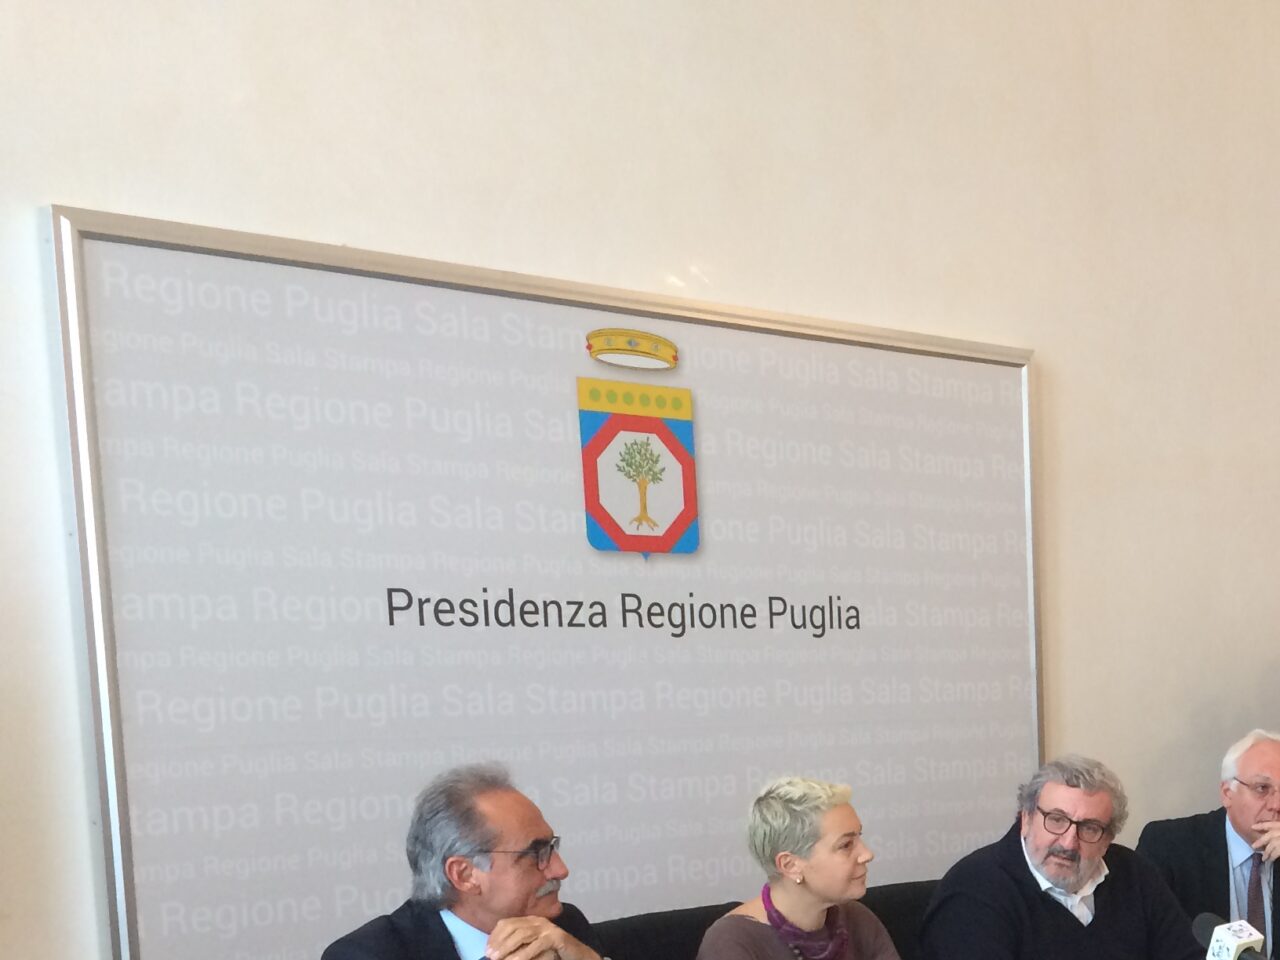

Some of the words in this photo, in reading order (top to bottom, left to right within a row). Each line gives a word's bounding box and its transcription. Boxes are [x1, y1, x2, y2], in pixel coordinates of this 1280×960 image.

[101, 260, 271, 316] Regione
[284, 284, 402, 335] Puglia
[415, 300, 490, 342] Sala
[500, 312, 584, 353] Stam
[760, 347, 840, 388] Puglia
[847, 359, 899, 392] Sala
[907, 367, 993, 407] Stampa
[104, 377, 221, 421] ampa
[236, 380, 393, 431] Regione
[405, 396, 513, 443] Puglia
[524, 408, 575, 443] Sal
[725, 428, 832, 468] Regione
[839, 438, 891, 471] Sala
[899, 445, 984, 483] Stampa
[118, 477, 287, 527] Regione
[301, 487, 417, 533] Puglia
[429, 494, 503, 530] Sala
[768, 515, 847, 552] Puglia
[854, 519, 905, 549] Sala
[913, 524, 997, 559] Stampa
[122, 592, 238, 630] ampa
[387, 587, 607, 627] Presidenza
[621, 592, 757, 638] Regione
[769, 595, 860, 638] Puglia
[856, 596, 897, 627] ala
[905, 600, 990, 635] Stampa
[136, 684, 302, 733] Regione
[315, 683, 430, 727] Puglia
[442, 681, 514, 716] Sala
[526, 682, 645, 720] Stampa
[655, 678, 767, 717] Regione
[775, 676, 853, 714] Puglia
[861, 675, 911, 704] Sala
[918, 675, 1001, 707] Stampa
[552, 773, 618, 808] Sala
[627, 771, 737, 805] Stampa
[855, 758, 906, 786] Sala
[914, 756, 997, 786] Stampa
[160, 890, 323, 940] Regione
